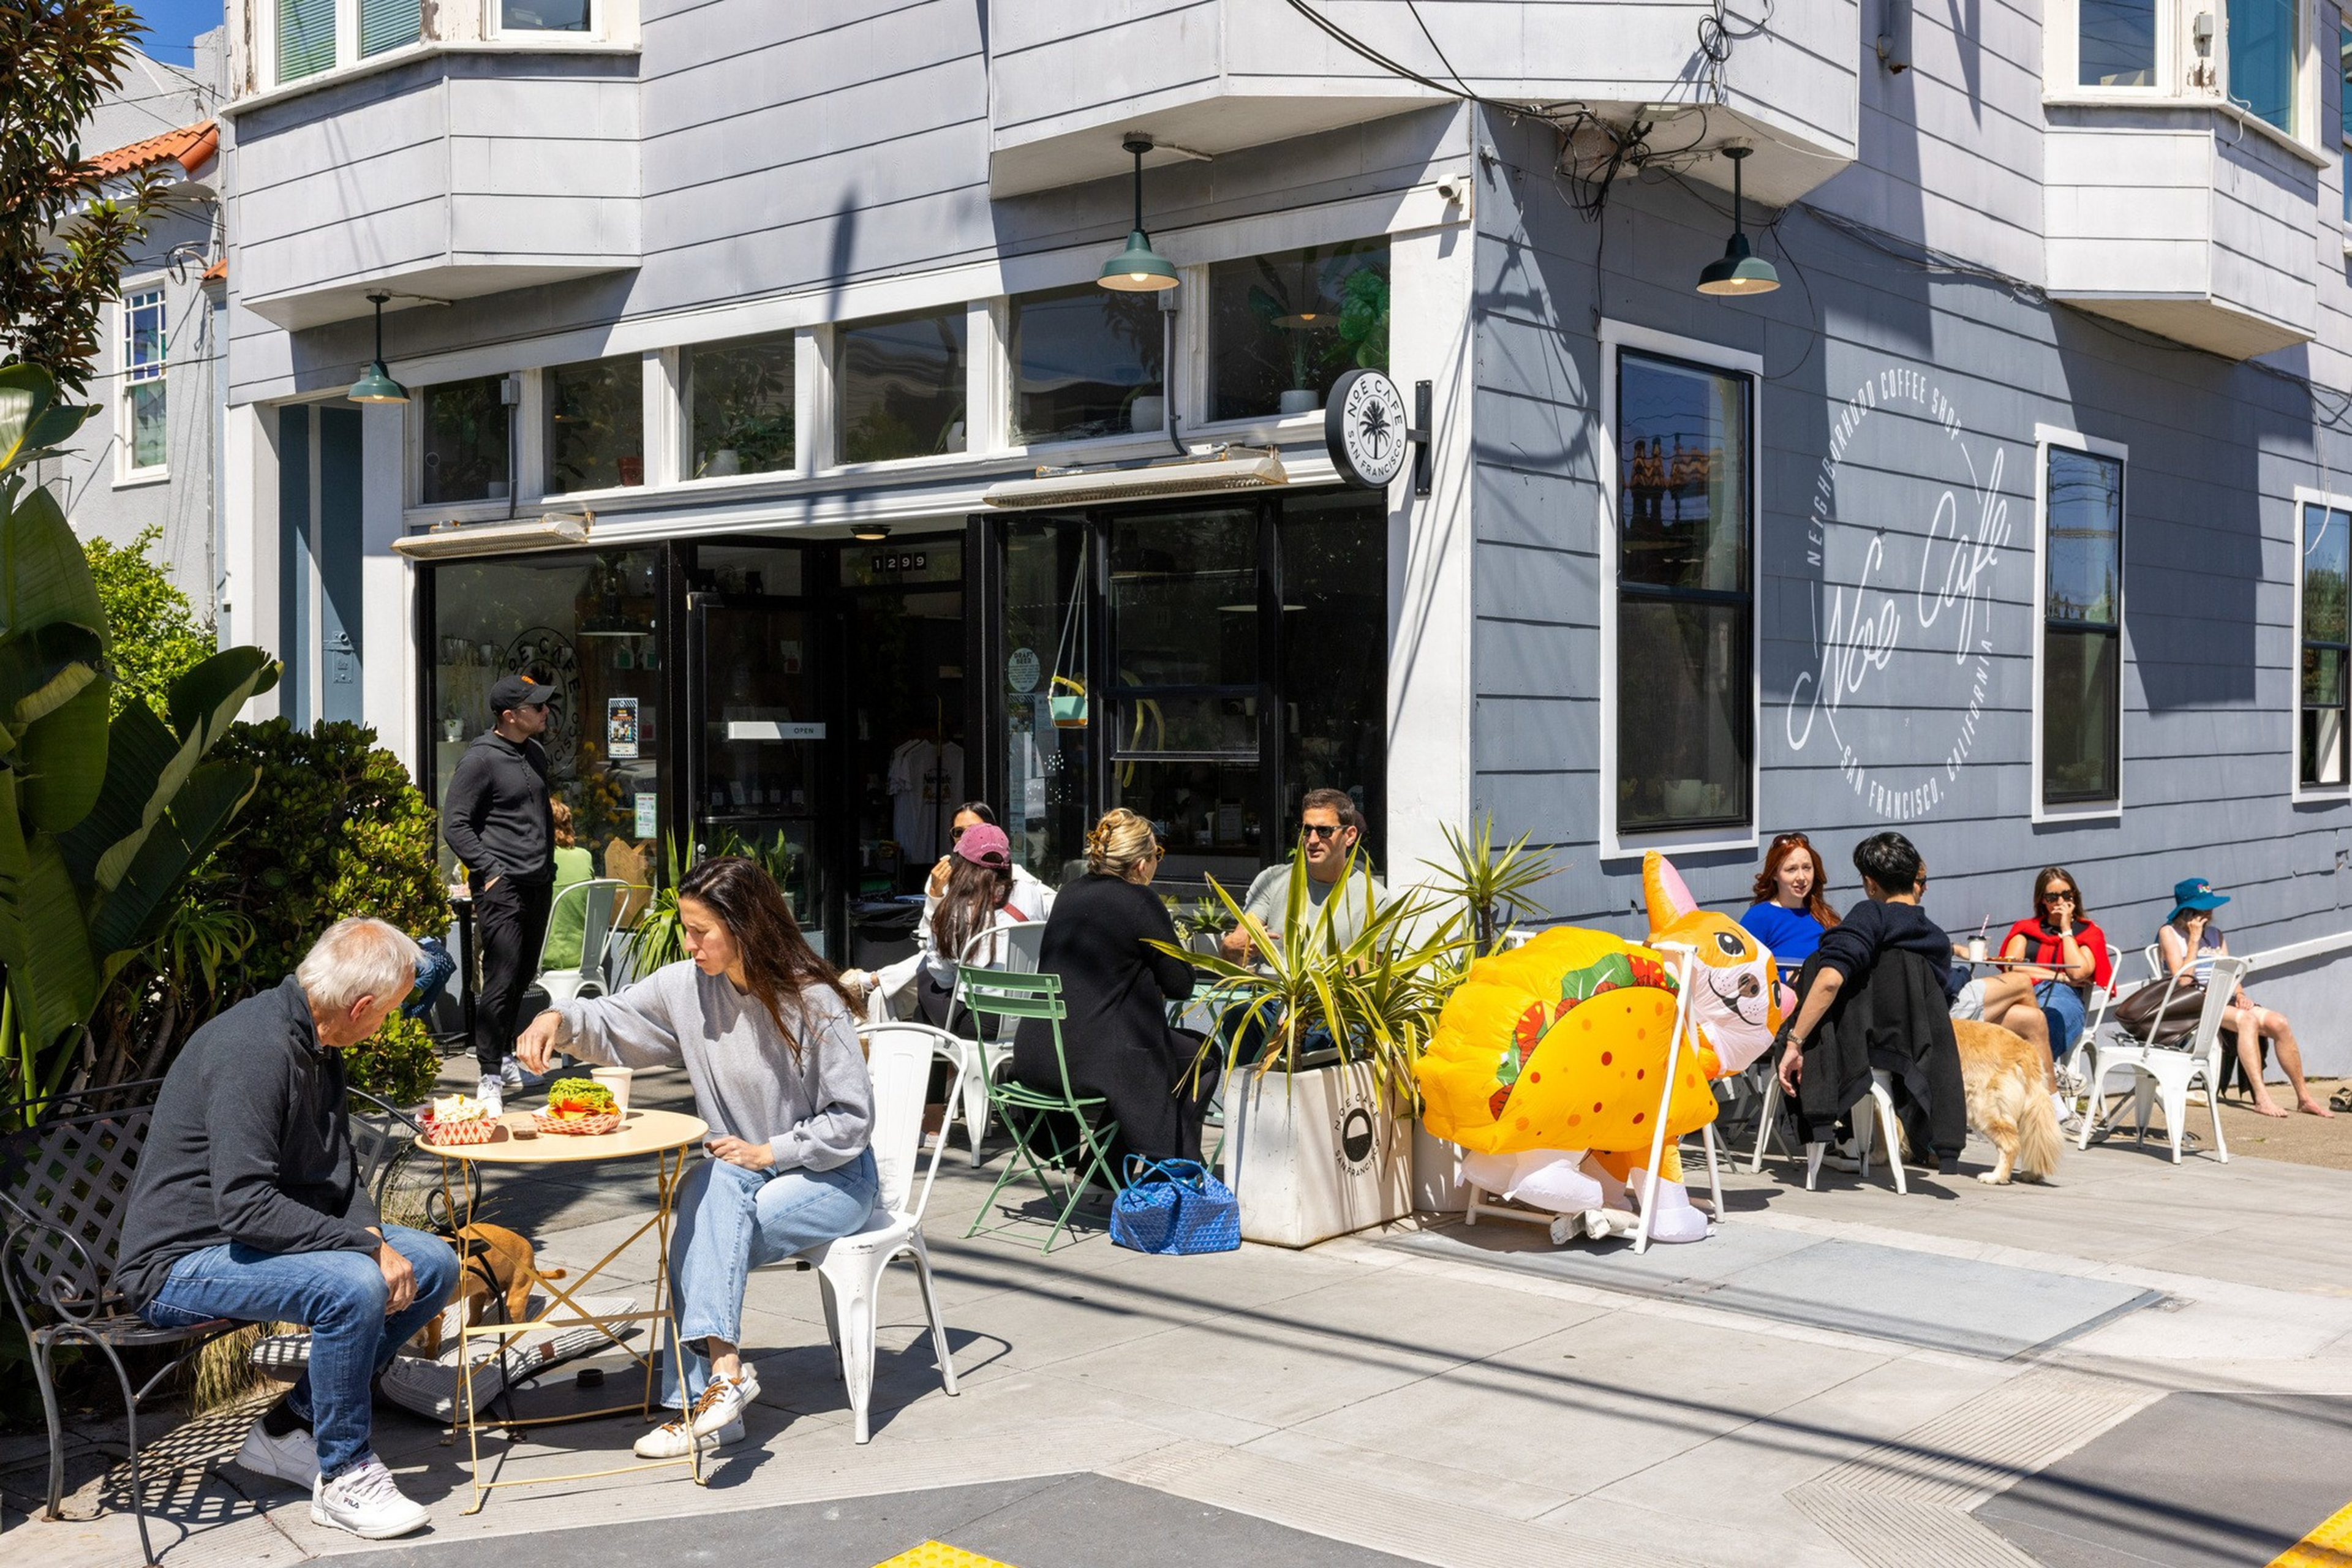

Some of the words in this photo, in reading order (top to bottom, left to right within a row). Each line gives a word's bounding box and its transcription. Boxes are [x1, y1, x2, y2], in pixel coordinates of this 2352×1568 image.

[1374, 379, 1403, 426] CAFE
[1348, 430, 1360, 460] SAN
[1360, 439, 1402, 477] FRANCISCO
[1807, 380, 1875, 567] NEIGHBORHOOD
[1880, 369, 1927, 405] COFFEE
[1931, 387, 1962, 442] SHOP
[875, 556, 925, 569] 1299
[1787, 535, 1900, 751] Noe
[1918, 447, 2011, 665] Cafe
[508, 640, 529, 675] OË
[538, 637, 581, 693] CAFE
[1839, 744, 1865, 796] SAN
[1868, 777, 1945, 820] FRANCISCO,
[1947, 639, 1993, 782] CALIFORNIA
[1335, 1149, 1346, 1171] SAN
[1346, 1138, 1381, 1177] FRANCISCO
[344, 1496, 360, 1509] FILA
